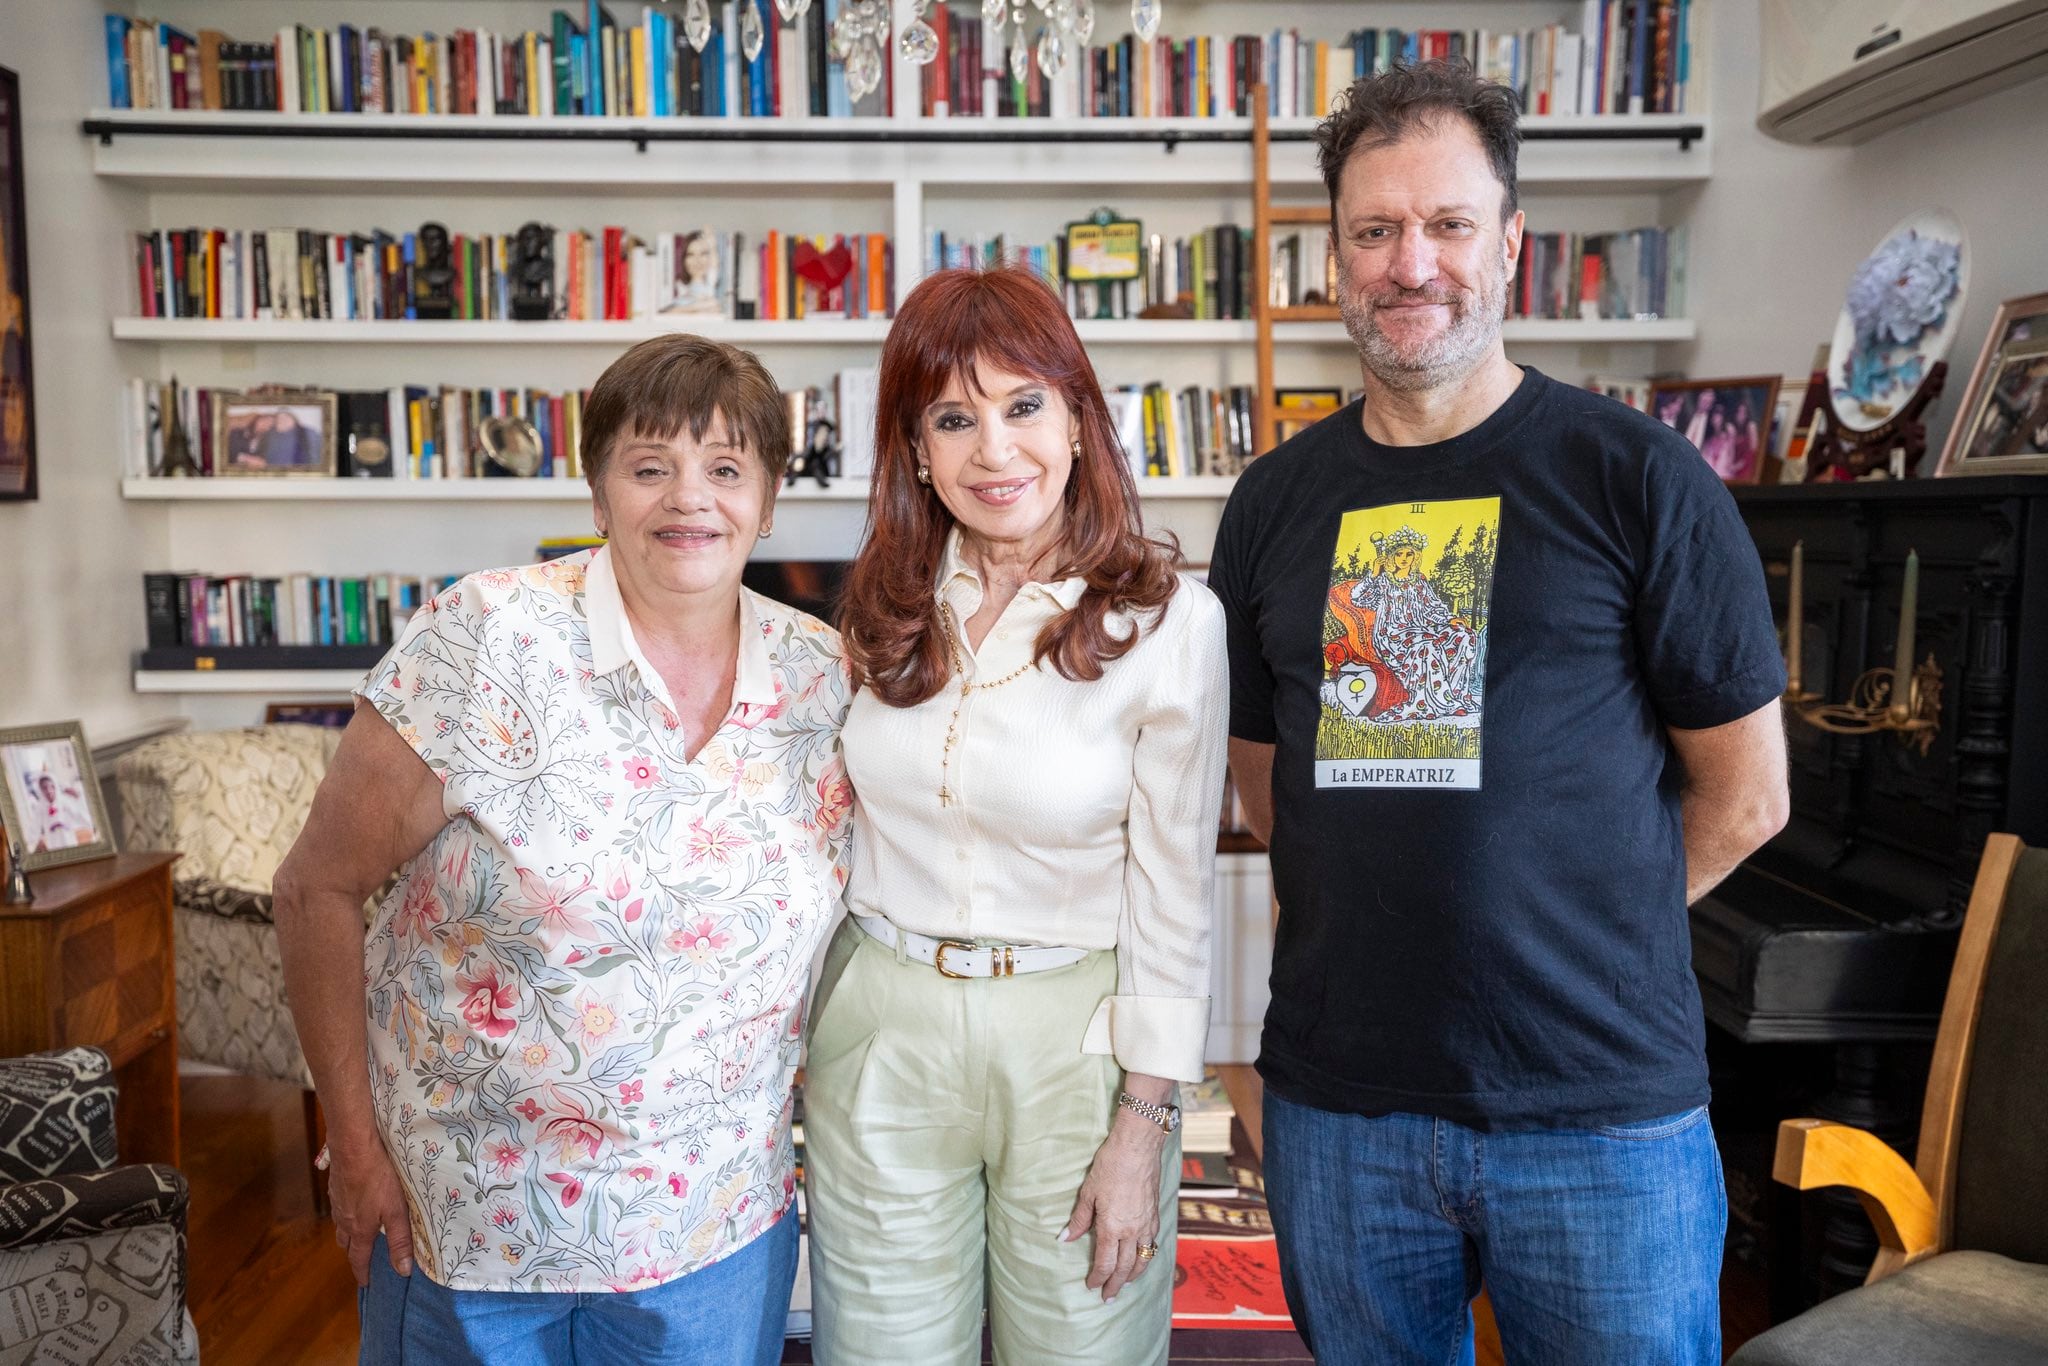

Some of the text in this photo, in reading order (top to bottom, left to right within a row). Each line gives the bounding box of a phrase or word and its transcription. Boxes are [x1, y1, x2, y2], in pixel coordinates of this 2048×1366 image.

[1410, 503, 1426, 514] III
[1332, 768, 1455, 783] La EMPERATRIZ
